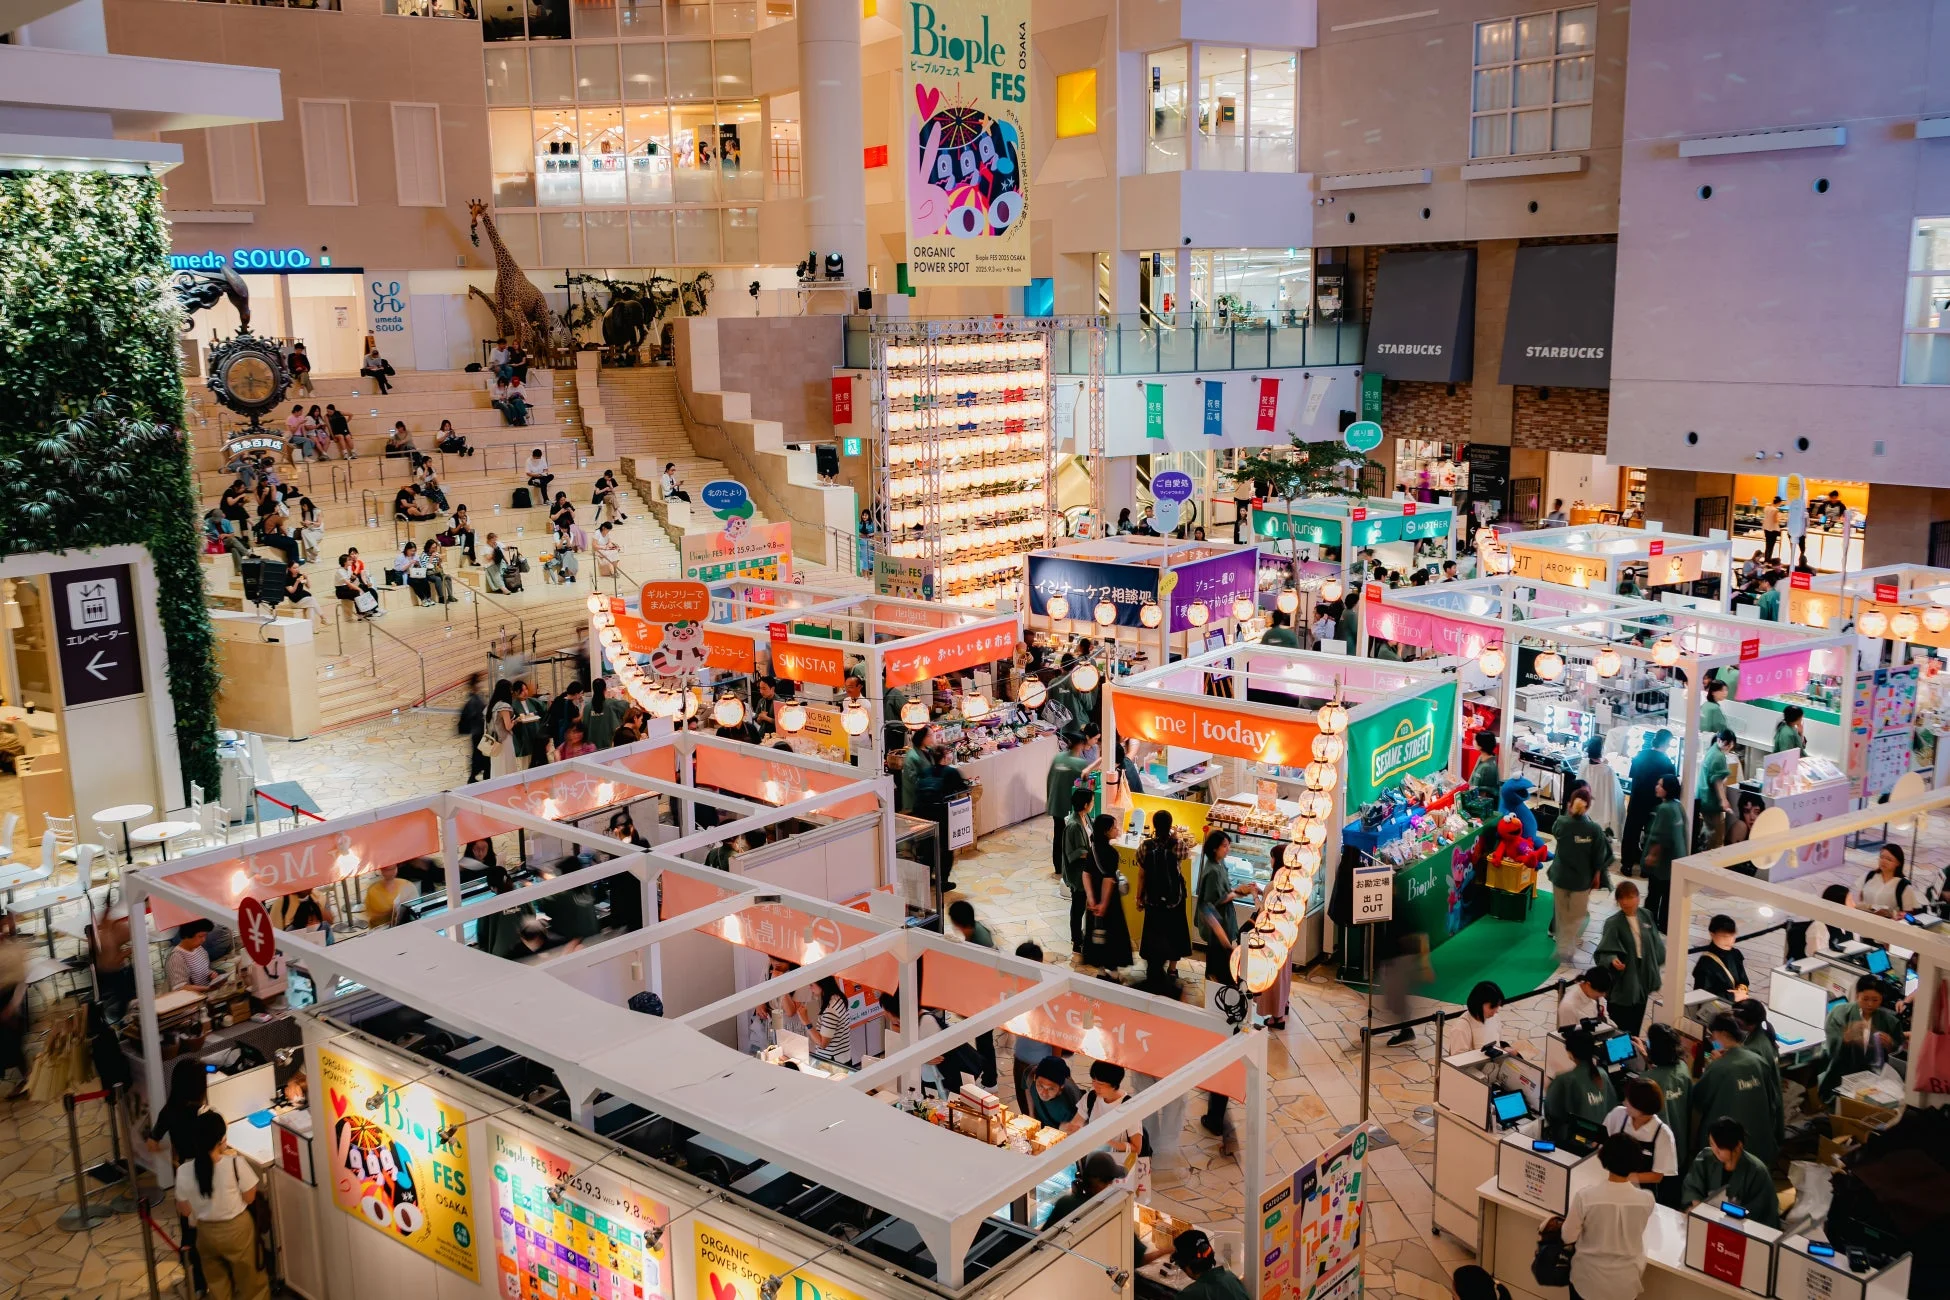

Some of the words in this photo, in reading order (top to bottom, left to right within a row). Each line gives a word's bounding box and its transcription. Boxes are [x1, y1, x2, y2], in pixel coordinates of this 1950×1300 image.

[910, 1, 1006, 74] Biople
[1018, 22, 1027, 70] OSAKA
[910, 61, 960, 77] ビープルフェス
[991, 72, 1026, 103] FES
[167, 250, 226, 268] meda
[233, 249, 311, 268] SOUQ
[913, 246, 955, 258] ORGANIC
[914, 262, 946, 273] POWER
[948, 262, 970, 273] SPOT
[375, 316, 402, 324] umeda
[1377, 343, 1442, 356] STARBUCKS
[1526, 346, 1604, 359] STARBUCKS
[1156, 480, 1189, 488] ご自愛処
[708, 489, 742, 497] 北のたより
[1417, 520, 1448, 531] MOTHER
[712, 550, 723, 558] FES
[909, 568, 922, 578] FES
[1545, 563, 1599, 578] AROMATICA
[647, 590, 705, 599] ギルトフリーで
[650, 601, 701, 610] まんぷく横丁
[66, 630, 130, 646] エレベーター
[779, 653, 836, 674] SUNSTAR
[891, 655, 931, 672] ビープル
[817, 714, 832, 723] BAR
[1155, 716, 1187, 734] me
[1202, 719, 1270, 754] today
[1375, 745, 1402, 777] SESAME
[1403, 730, 1431, 762] STREET
[1355, 877, 1390, 889] お勘定場
[1408, 867, 1438, 901] Biople
[1362, 904, 1384, 913] OUT
[432, 1160, 467, 1197] FES
[1304, 1177, 1315, 1192] MAP
[530, 1156, 548, 1174] FES
[623, 1200, 641, 1219] 9.8
[435, 1193, 468, 1217] OSAKA
[1265, 1189, 1289, 1211] CATEGORY
[701, 1233, 750, 1264] ORGANIC
[701, 1248, 738, 1273] POWER
